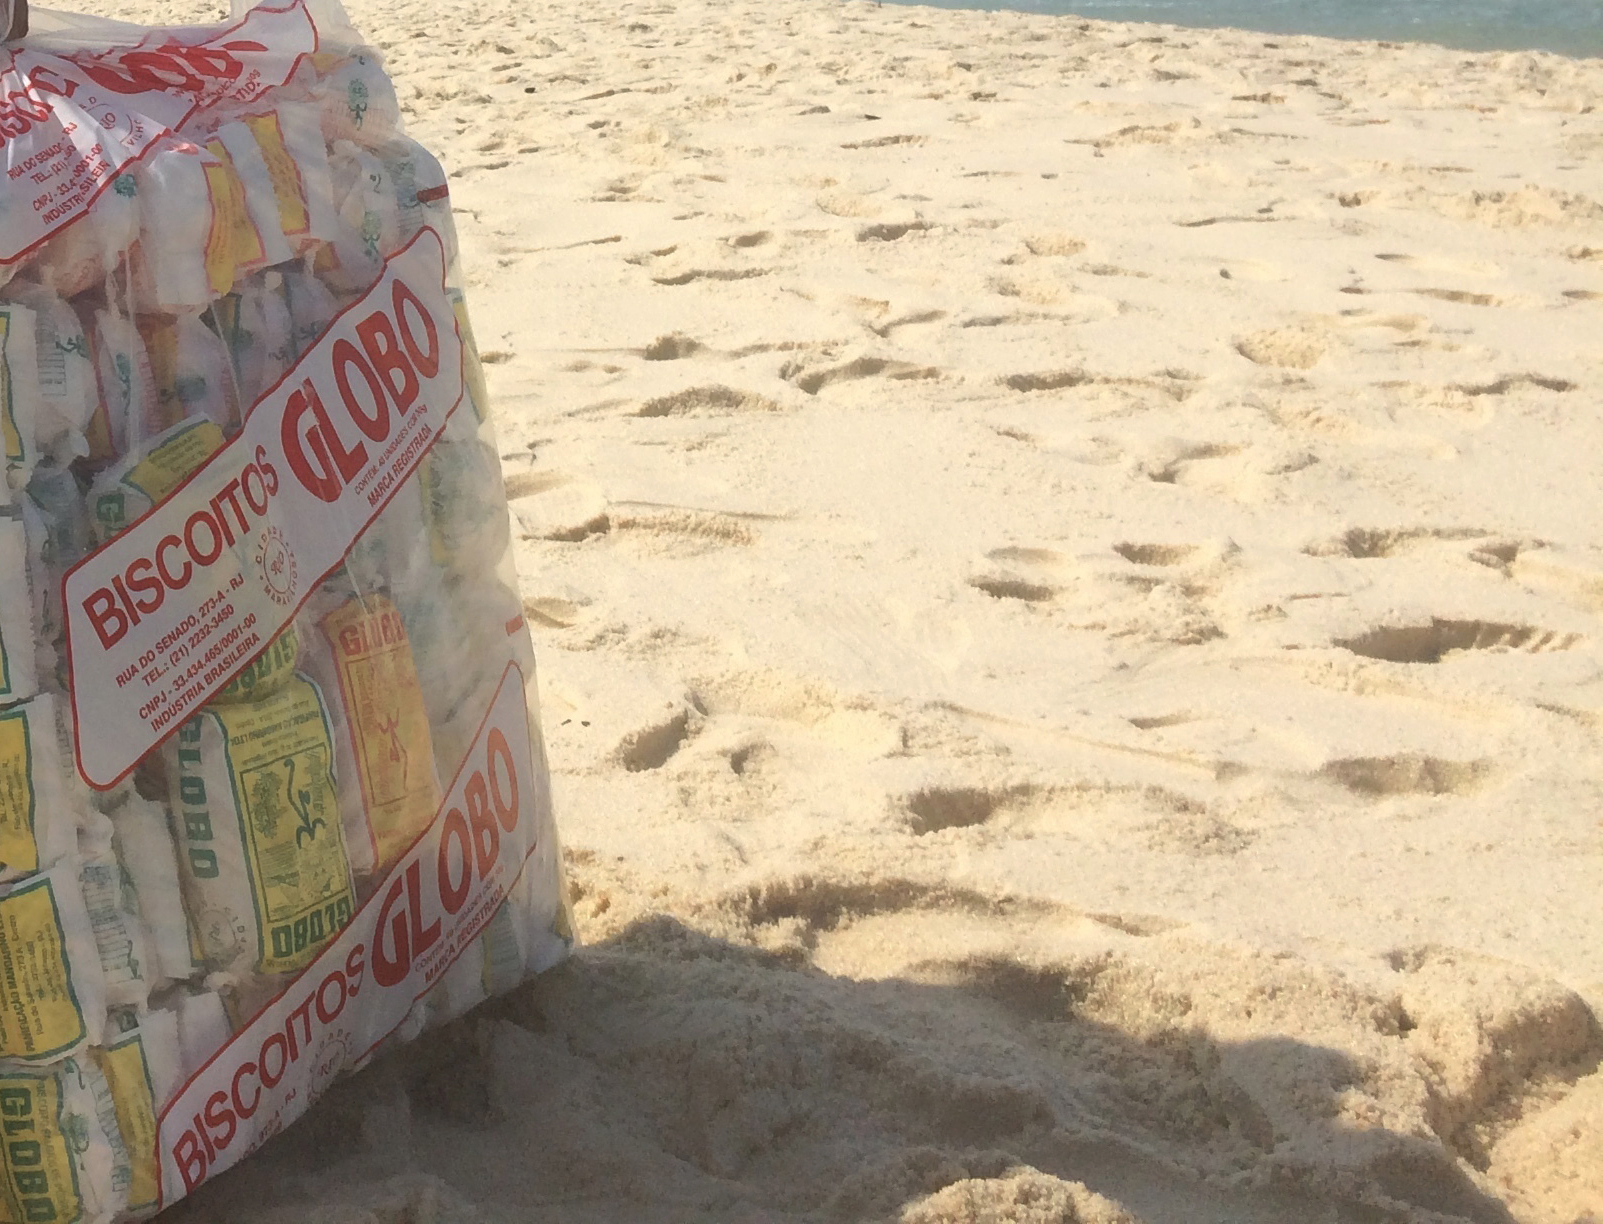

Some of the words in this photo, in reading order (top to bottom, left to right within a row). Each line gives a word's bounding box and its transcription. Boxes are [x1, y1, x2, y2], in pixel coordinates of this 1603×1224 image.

[7, 165, 26, 180] RUA
[62, 122, 77, 135] RJ
[82, 445, 279, 651] BISCOITOS
[280, 278, 439, 503] GLOBO
[366, 469, 397, 507] MARCA
[395, 423, 433, 478] REGISTRADA
[116, 664, 139, 688] RUA
[139, 649, 156, 668] DO
[155, 614, 200, 654] SENADO,
[198, 589, 226, 618] 273-A
[229, 573, 246, 591] RJ
[139, 690, 167, 720] CNPJ
[174, 613, 257, 692] 33.434.465/0001-00
[141, 663, 170, 687] TEL.:
[169, 644, 189, 668] (21)
[187, 605, 235, 649] 2232-3450
[150, 680, 205, 732] INDÚSTRIA
[205, 632, 260, 686] BRASILEIRA
[172, 943, 366, 1195] BISCOITOS
[371, 727, 519, 988] GLOBO
[424, 943, 456, 983] MARCA
[456, 883, 505, 948] REGISTRADA
